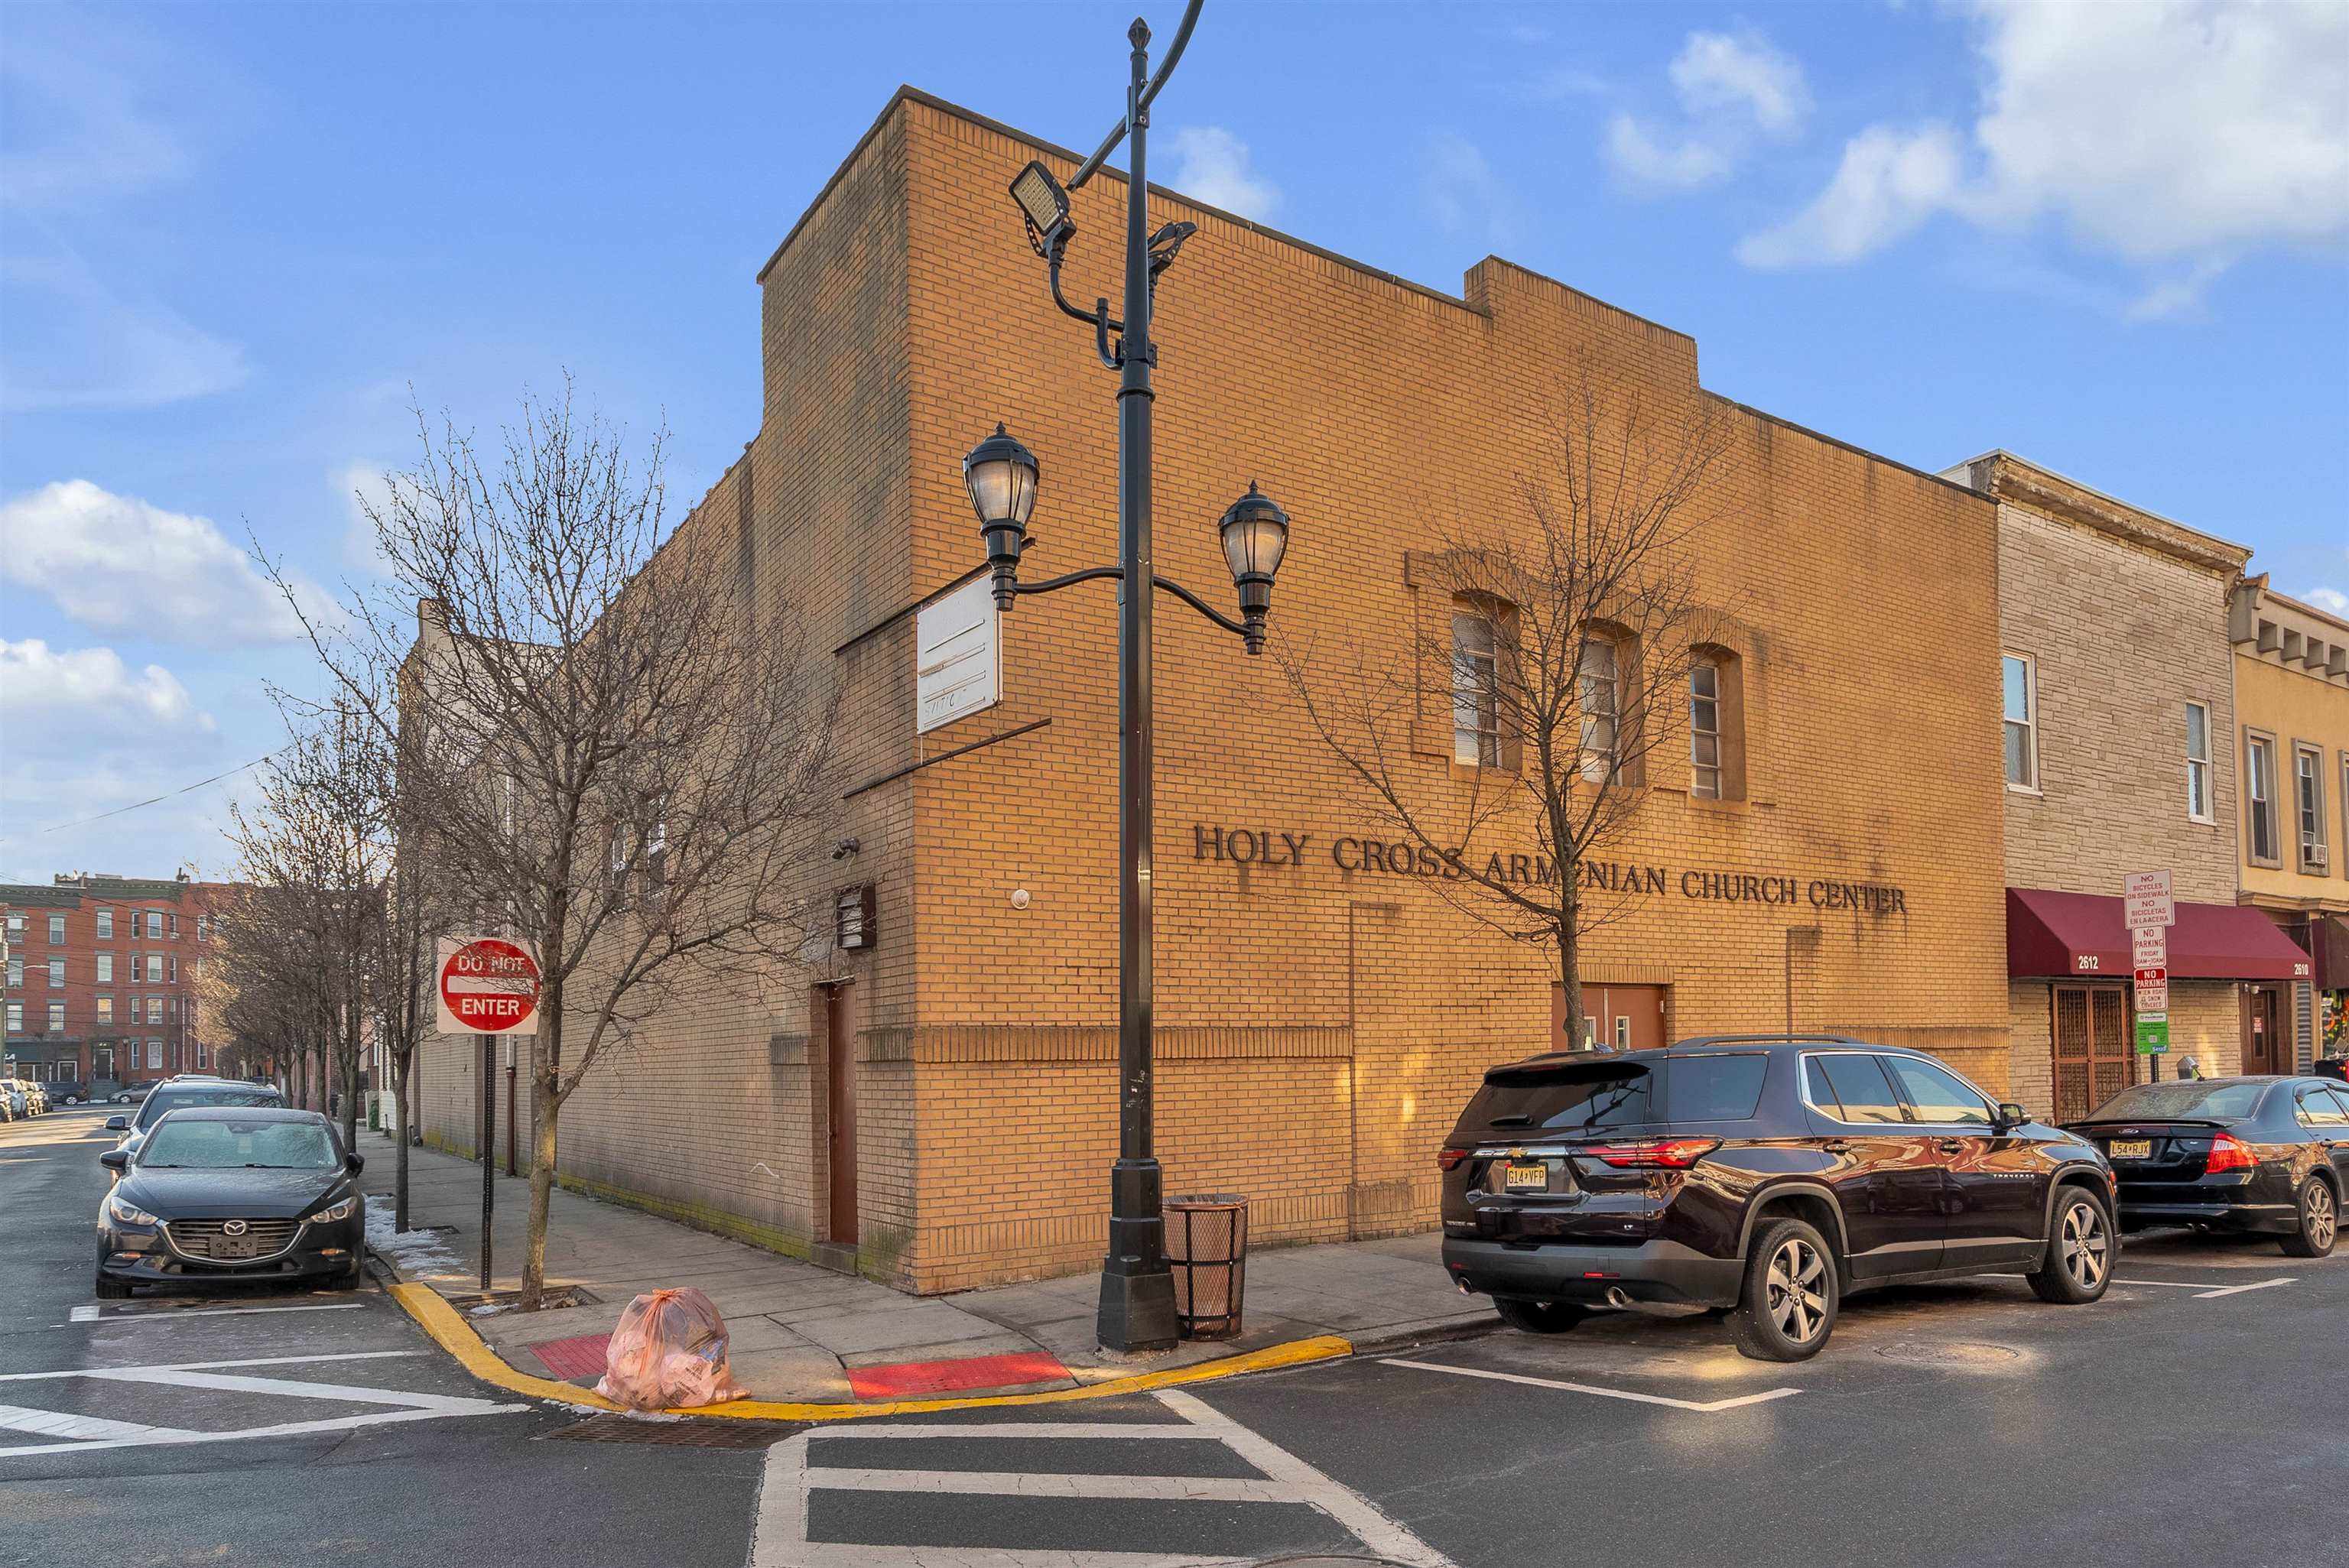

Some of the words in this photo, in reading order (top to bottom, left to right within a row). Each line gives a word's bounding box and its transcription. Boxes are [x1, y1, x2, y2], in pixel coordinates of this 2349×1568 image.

[1194, 825, 1311, 865] HOLY
[1334, 837, 1463, 878] CROSS
[1681, 871, 1797, 904] CHURCH
[1808, 880, 1908, 912] CENTER
[2133, 882, 2163, 891] BICYCLES
[2137, 890, 2169, 899] SIDEWALK
[2131, 907, 2166, 917] BICICLETAS
[2143, 929, 2155, 938] NO
[2135, 939, 2164, 950] PARKING
[458, 955, 483, 972] DO
[491, 956, 525, 972] NOT
[2078, 955, 2099, 969] 2612
[2143, 970, 2157, 979] NO
[2294, 963, 2309, 976] 2610
[2136, 979, 2165, 989] PARKING
[461, 998, 520, 1016] ENTER
